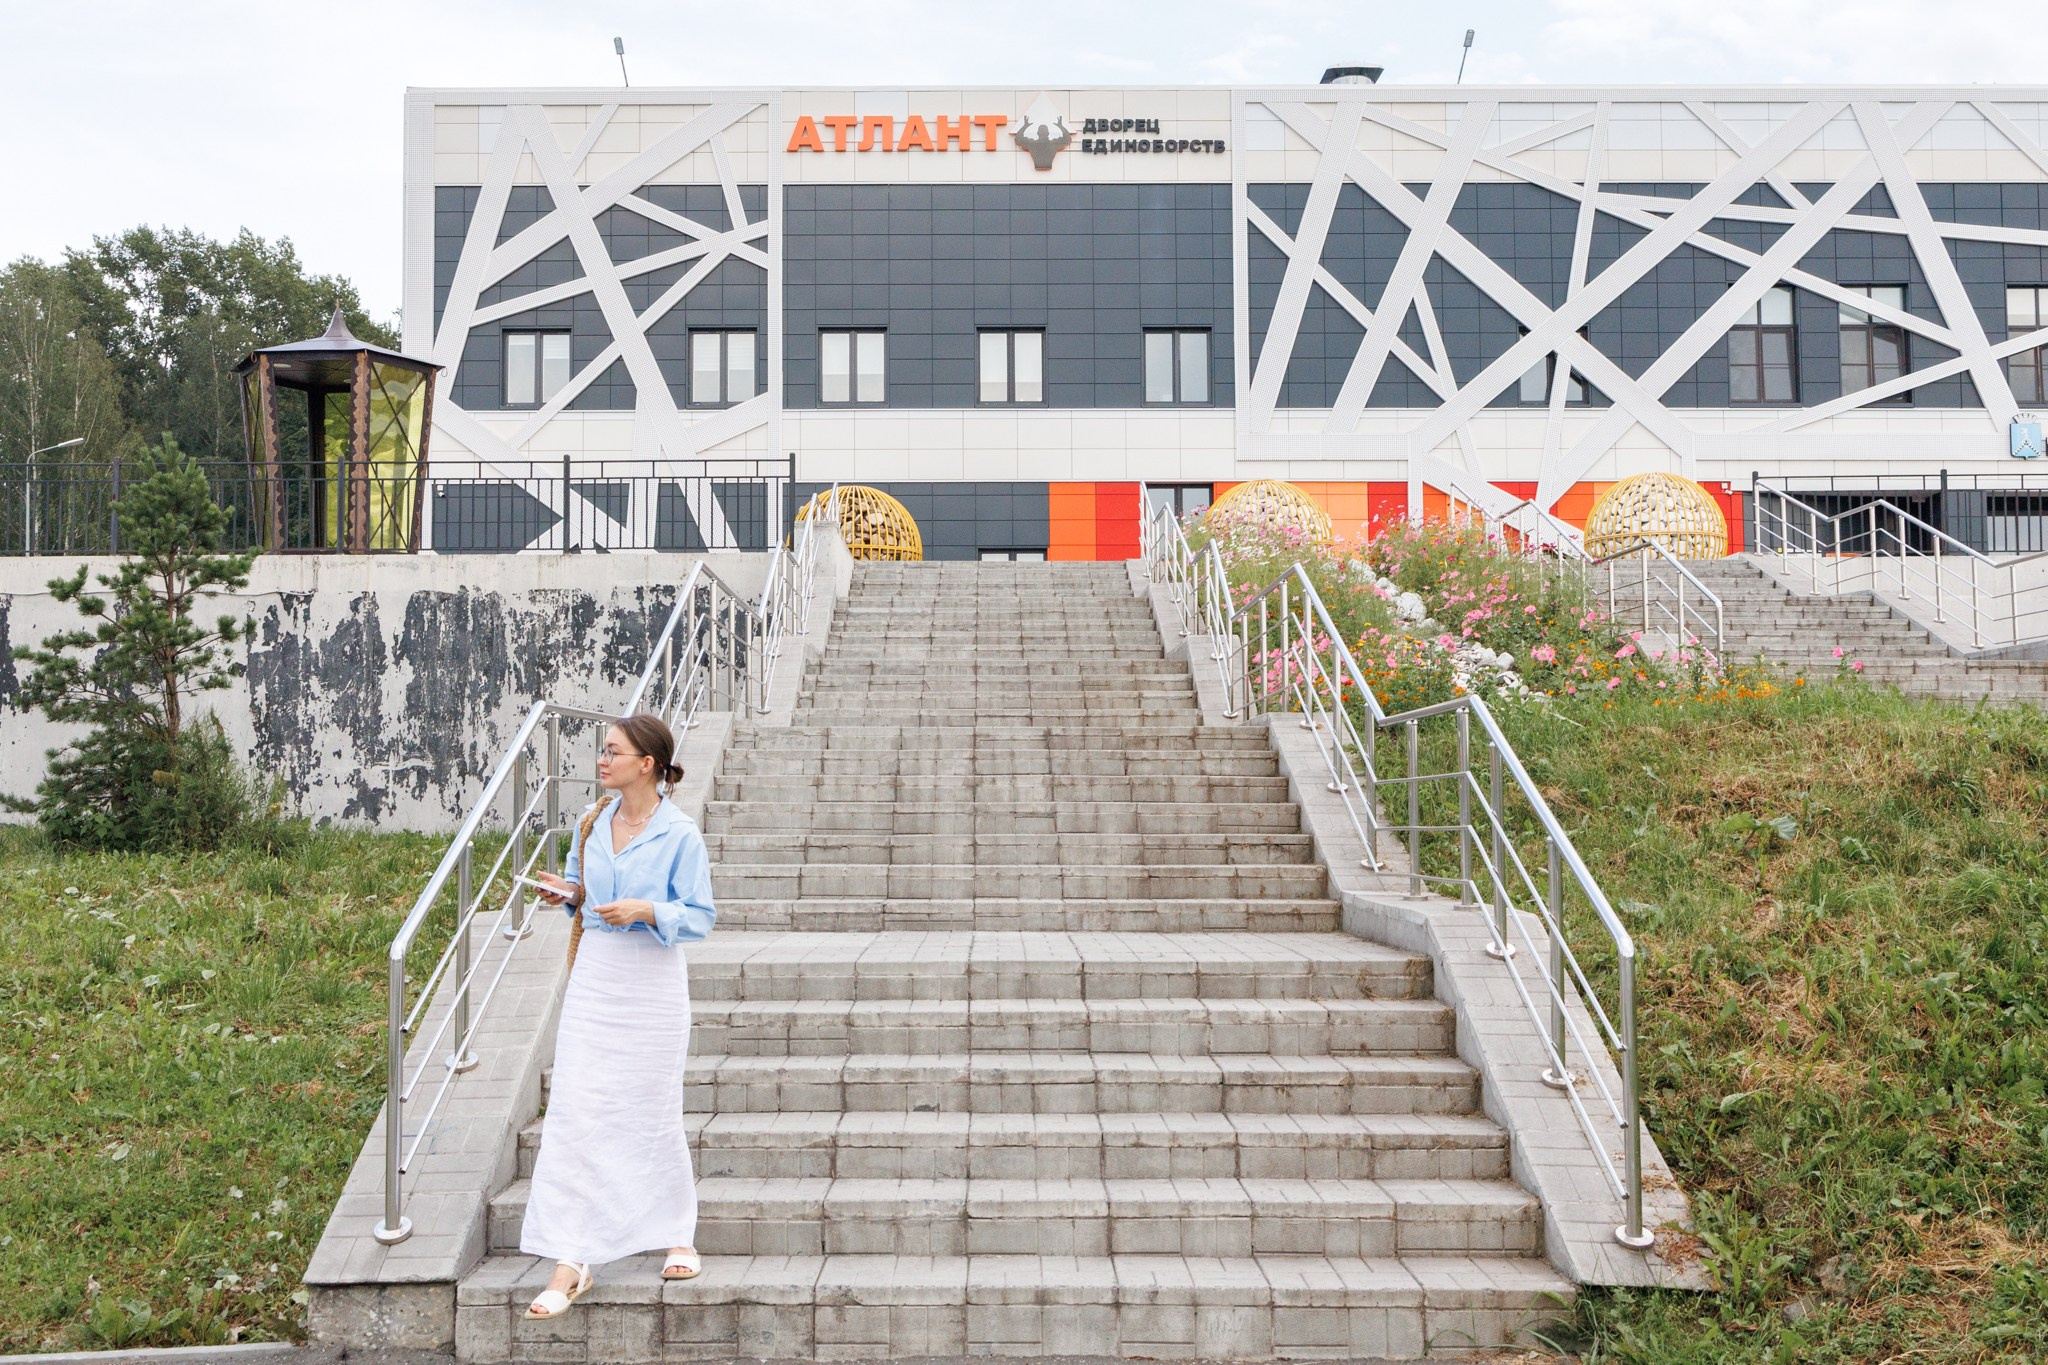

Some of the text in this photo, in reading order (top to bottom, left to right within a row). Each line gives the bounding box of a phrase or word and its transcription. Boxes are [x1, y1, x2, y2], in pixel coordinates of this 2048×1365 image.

[787, 115, 1008, 152] АТЛАНТ
[1082, 118, 1160, 134] ДВОРЕЦ
[1081, 139, 1226, 155] ЕДИНОБОРСТВ
